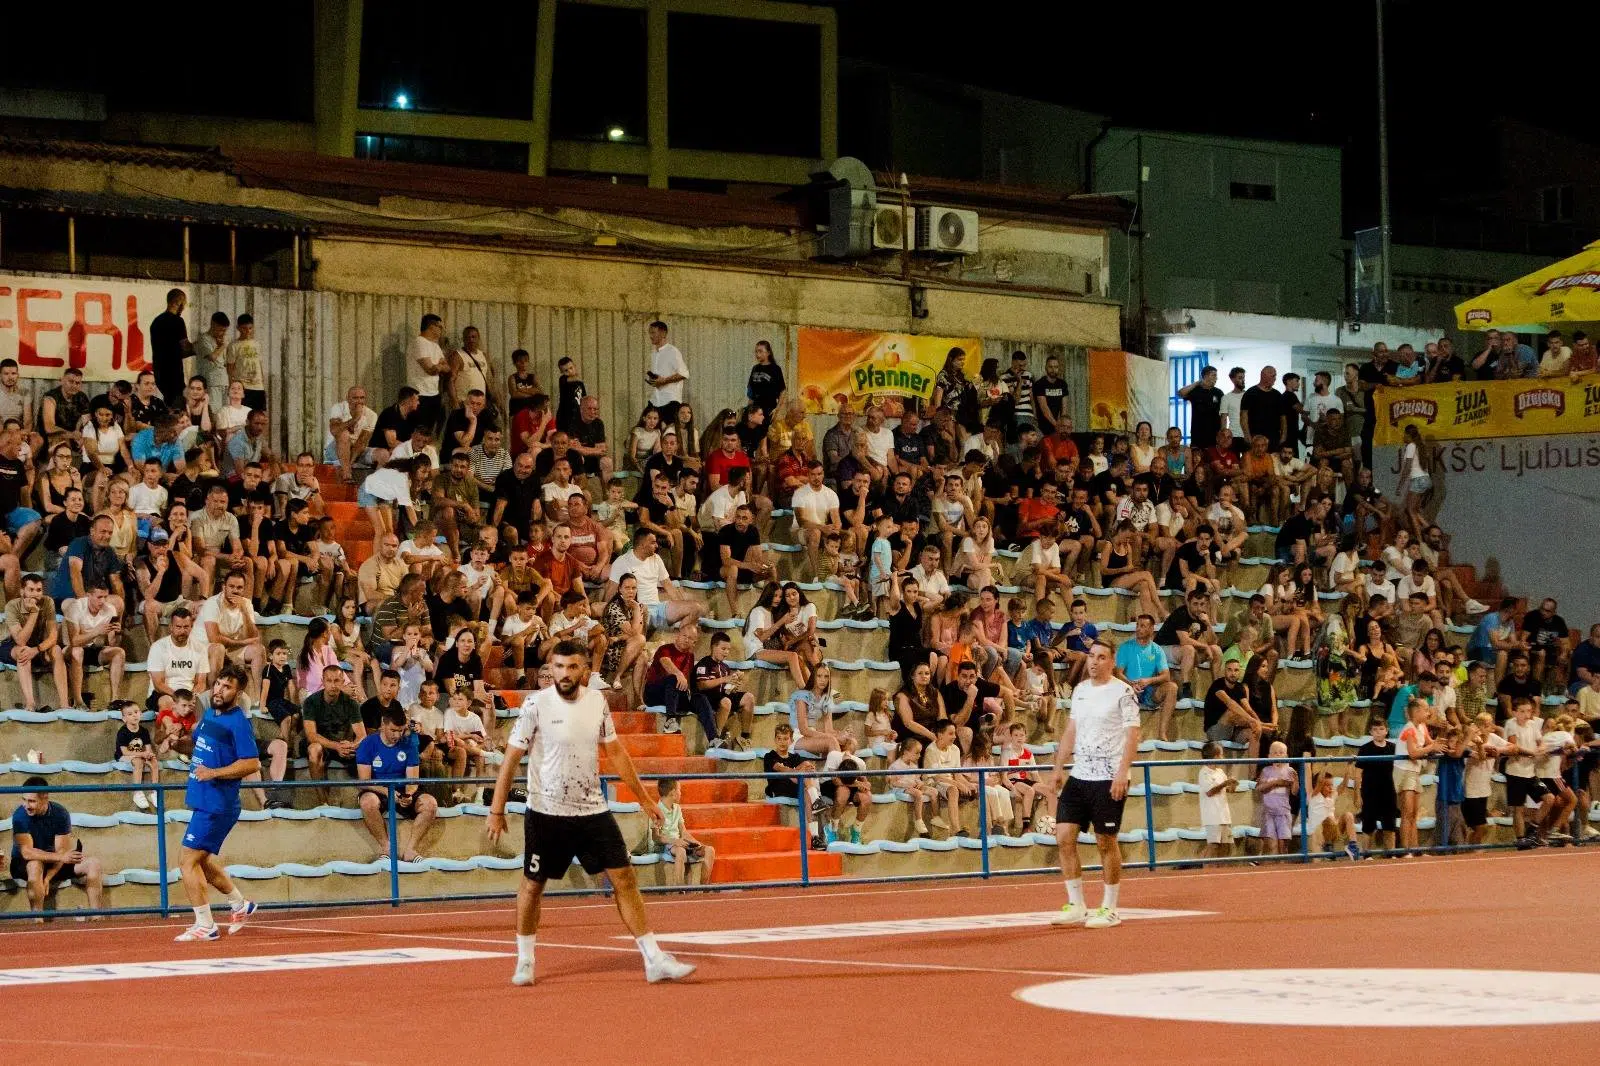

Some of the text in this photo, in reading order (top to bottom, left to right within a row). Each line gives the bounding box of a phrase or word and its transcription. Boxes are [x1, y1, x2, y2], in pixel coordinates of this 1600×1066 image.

[0, 287, 153, 371] EAL
[1456, 389, 1488, 414] ŽUJA
[529, 854, 541, 873] 5
